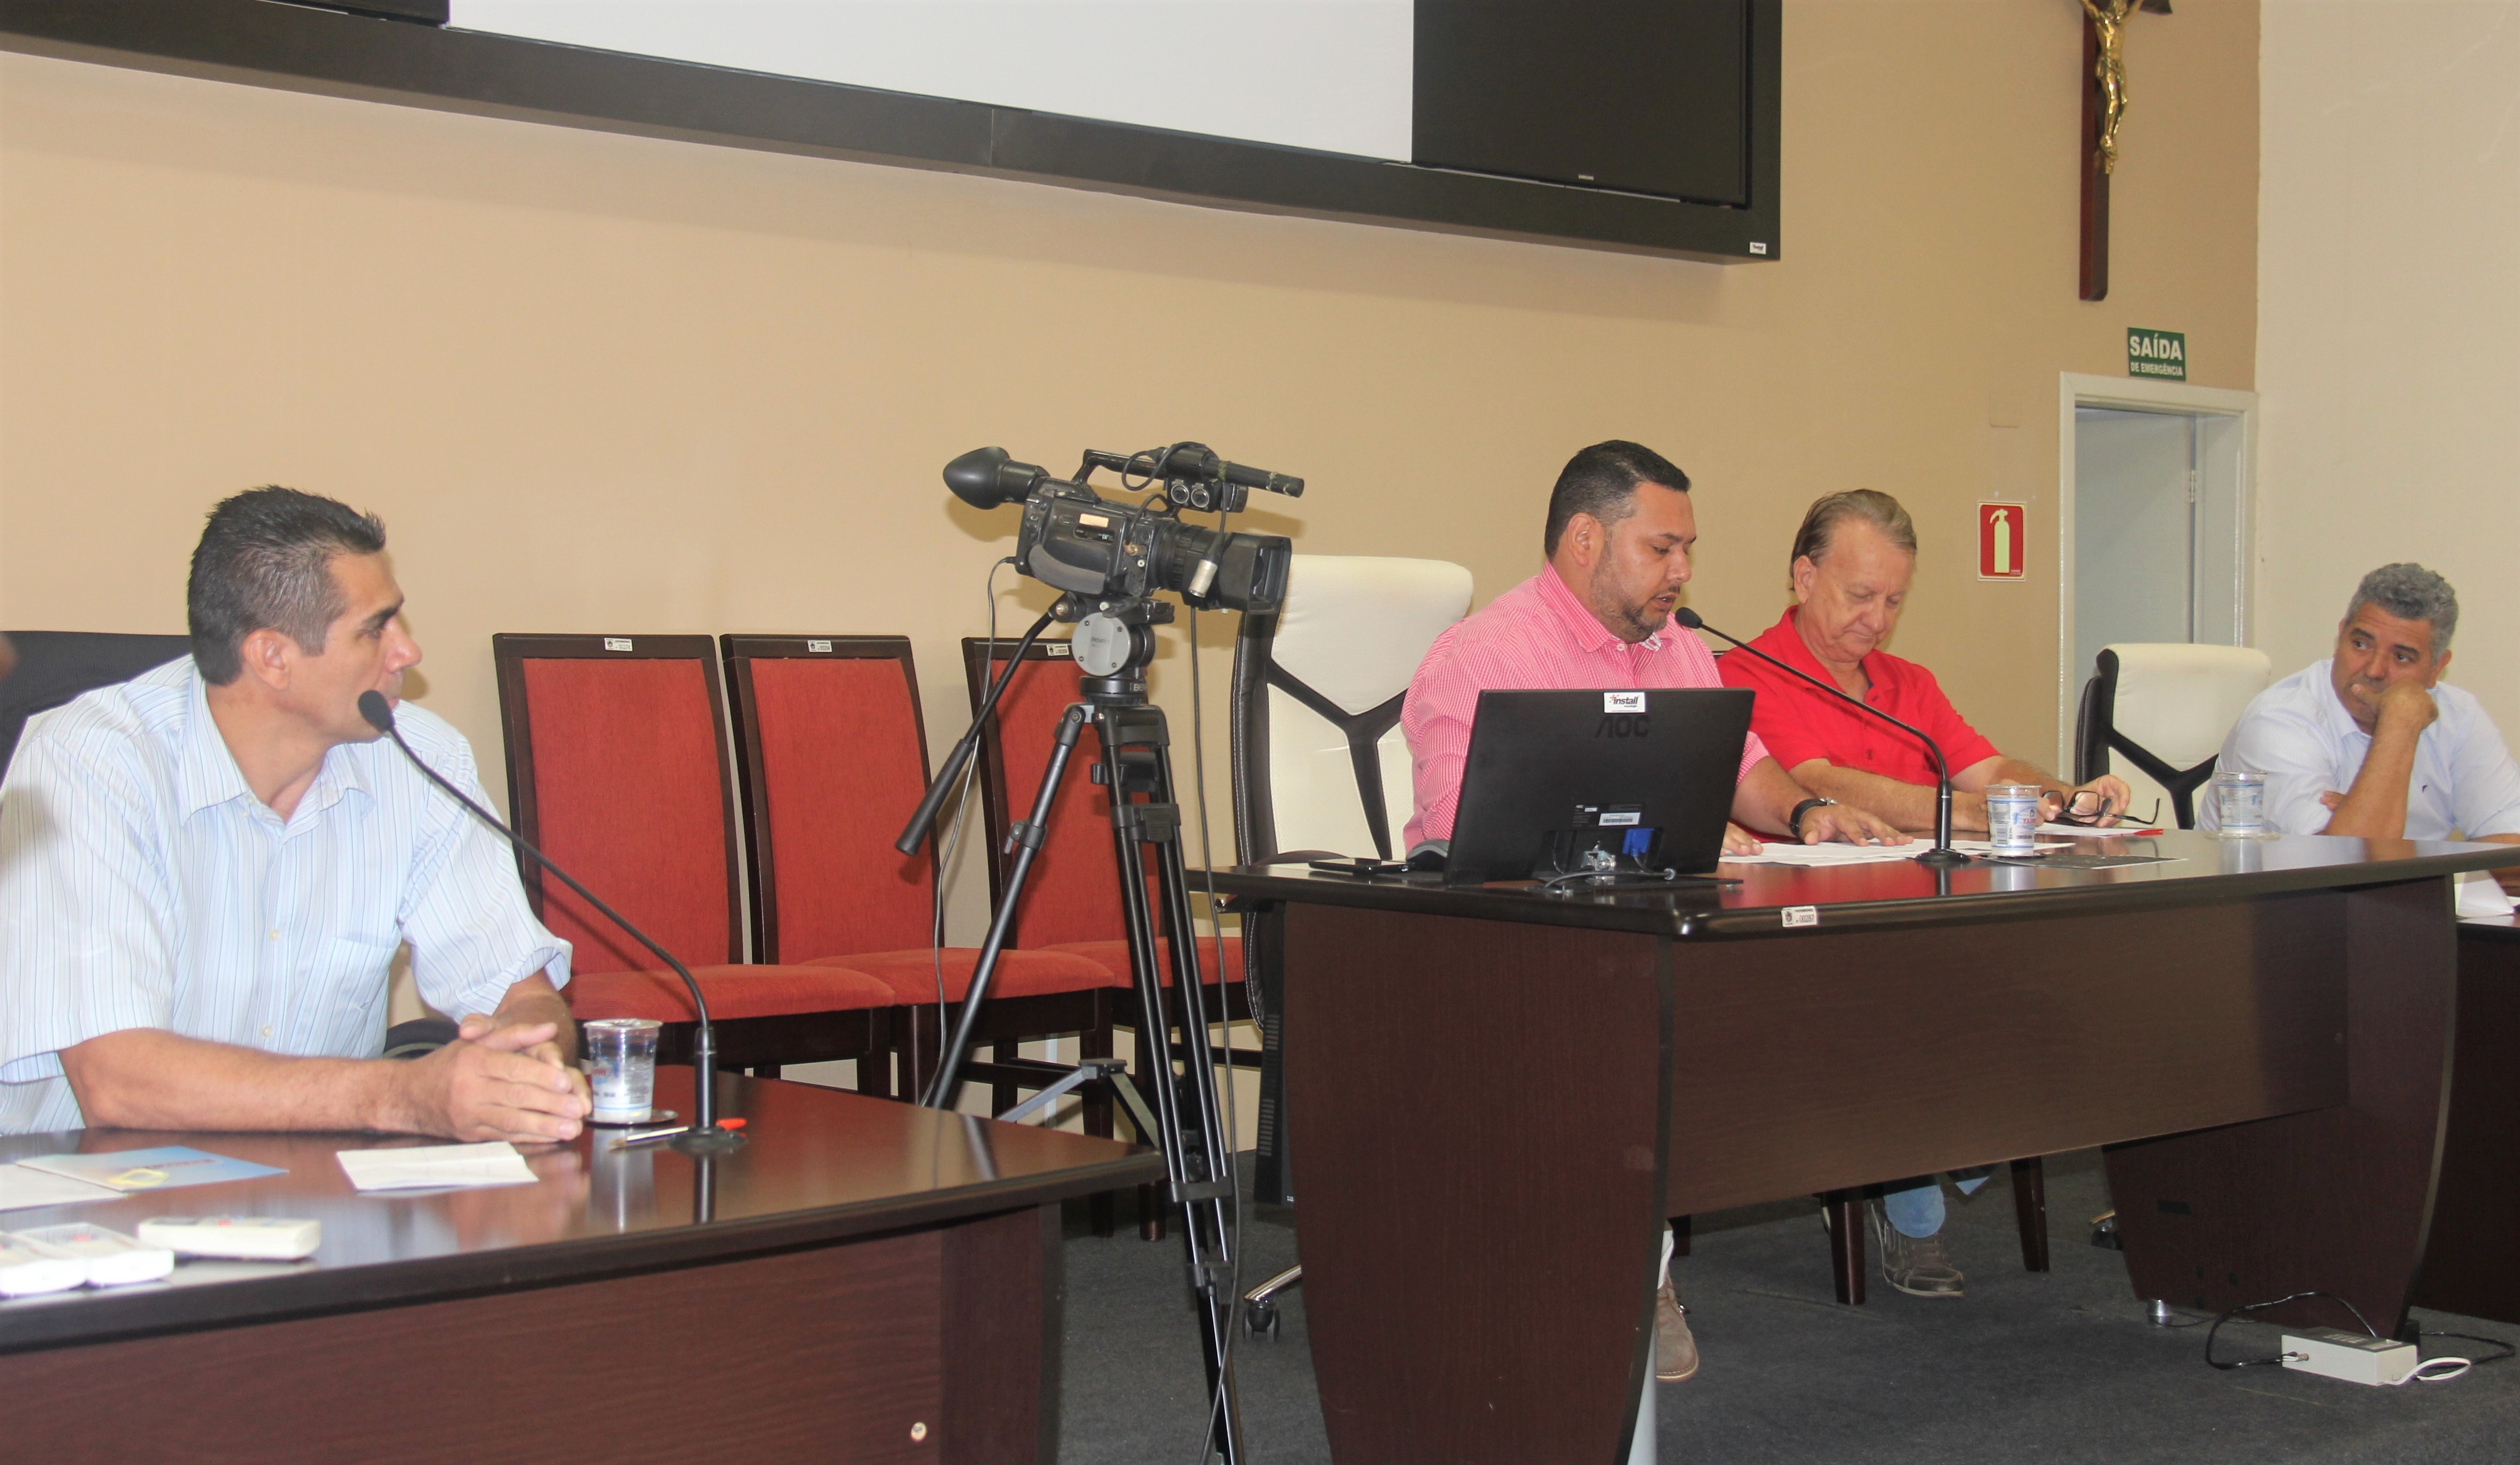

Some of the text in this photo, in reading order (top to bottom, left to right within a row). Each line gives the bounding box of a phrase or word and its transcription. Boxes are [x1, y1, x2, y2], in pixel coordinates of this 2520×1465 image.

[2130, 334, 2183, 361] SAÍDA
[2131, 362, 2140, 372] DE
[1613, 696, 1639, 705] install
[1594, 715, 1649, 738] AOC
